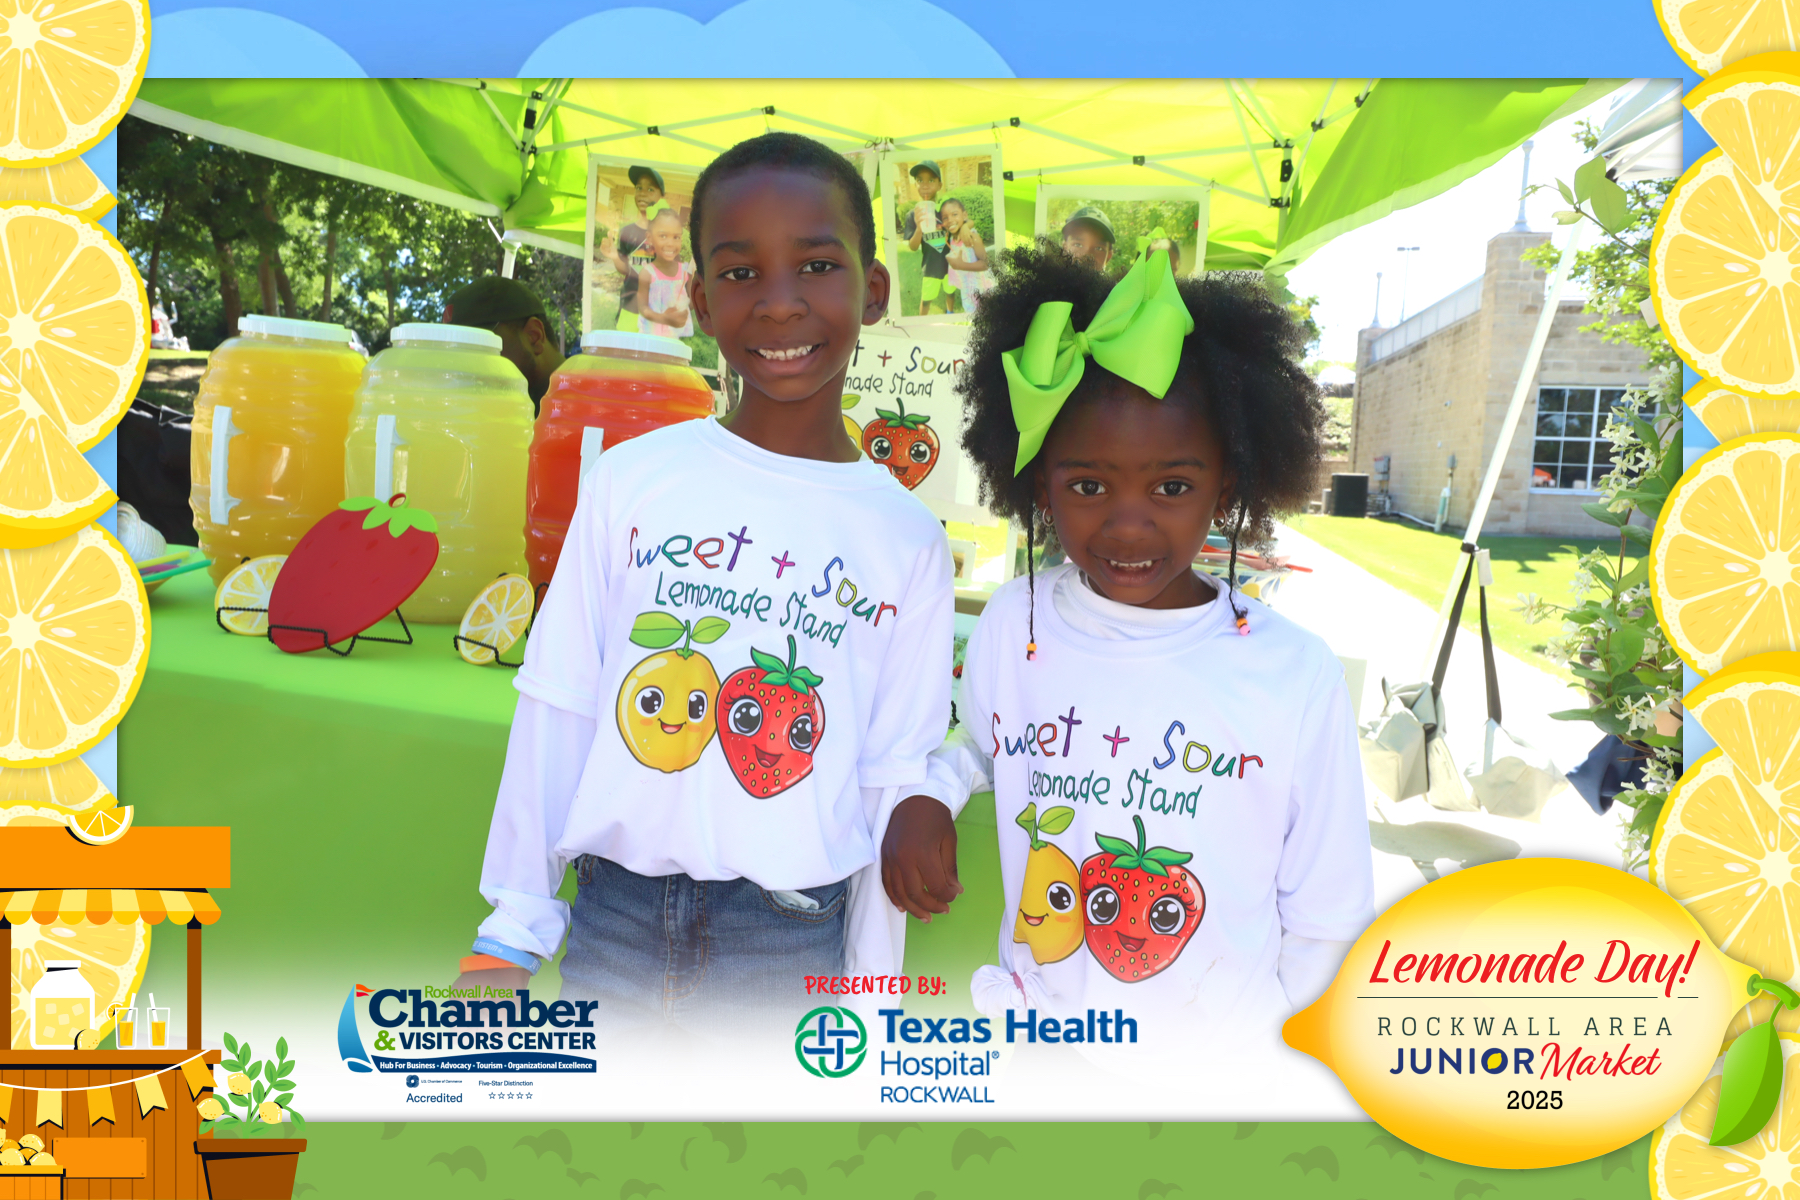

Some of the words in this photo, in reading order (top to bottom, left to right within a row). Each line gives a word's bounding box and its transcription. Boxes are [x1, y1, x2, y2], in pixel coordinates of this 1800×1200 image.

[844, 374, 883, 393] nade
[889, 372, 934, 398] Stand
[905, 346, 965, 375] Sour
[627, 526, 753, 572] Sweet
[771, 550, 796, 579] +
[811, 556, 898, 627] Sour
[655, 571, 772, 622] Lemonade
[779, 591, 848, 649] Stand
[992, 706, 1082, 758] Sweet
[1102, 725, 1130, 758] +
[1153, 720, 1263, 779] Sour
[1122, 768, 1203, 819] Stand
